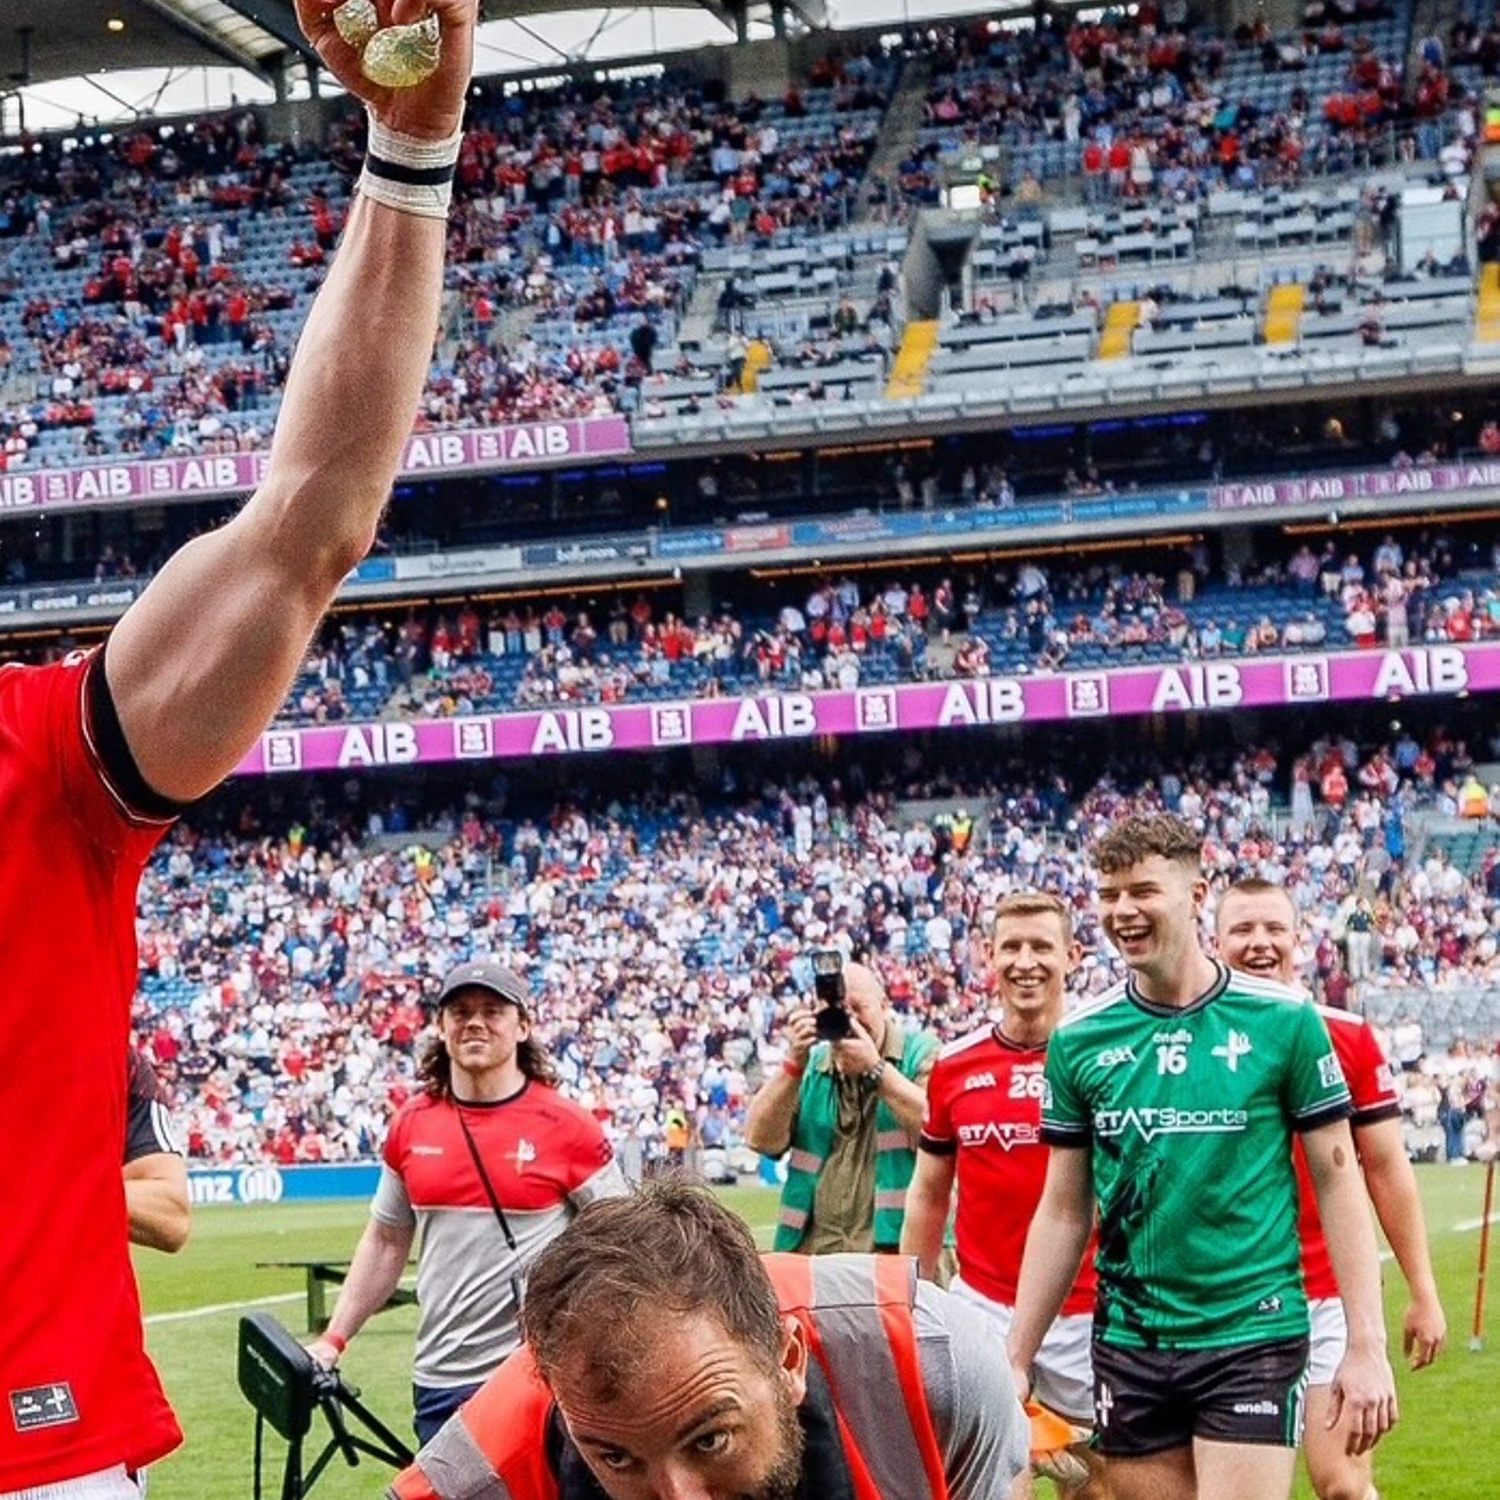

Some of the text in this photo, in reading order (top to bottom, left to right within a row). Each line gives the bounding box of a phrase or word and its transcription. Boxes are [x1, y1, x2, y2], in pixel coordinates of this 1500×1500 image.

[406, 435, 465, 468] AIB
[510, 426, 569, 457] AIB
[76, 468, 132, 498] AIB
[181, 458, 238, 489] AIB
[1308, 478, 1343, 499] AIB
[1396, 470, 1433, 491] AIB
[1242, 485, 1276, 504] AIB
[1151, 664, 1243, 712] AIB
[1372, 648, 1468, 697] AIB
[732, 697, 816, 739] AIB
[937, 681, 1025, 725] AIB
[338, 723, 418, 767] AIB
[532, 710, 613, 753] AIB
[1156, 1044, 1187, 1075] 16
[1008, 1073, 1045, 1099] 26
